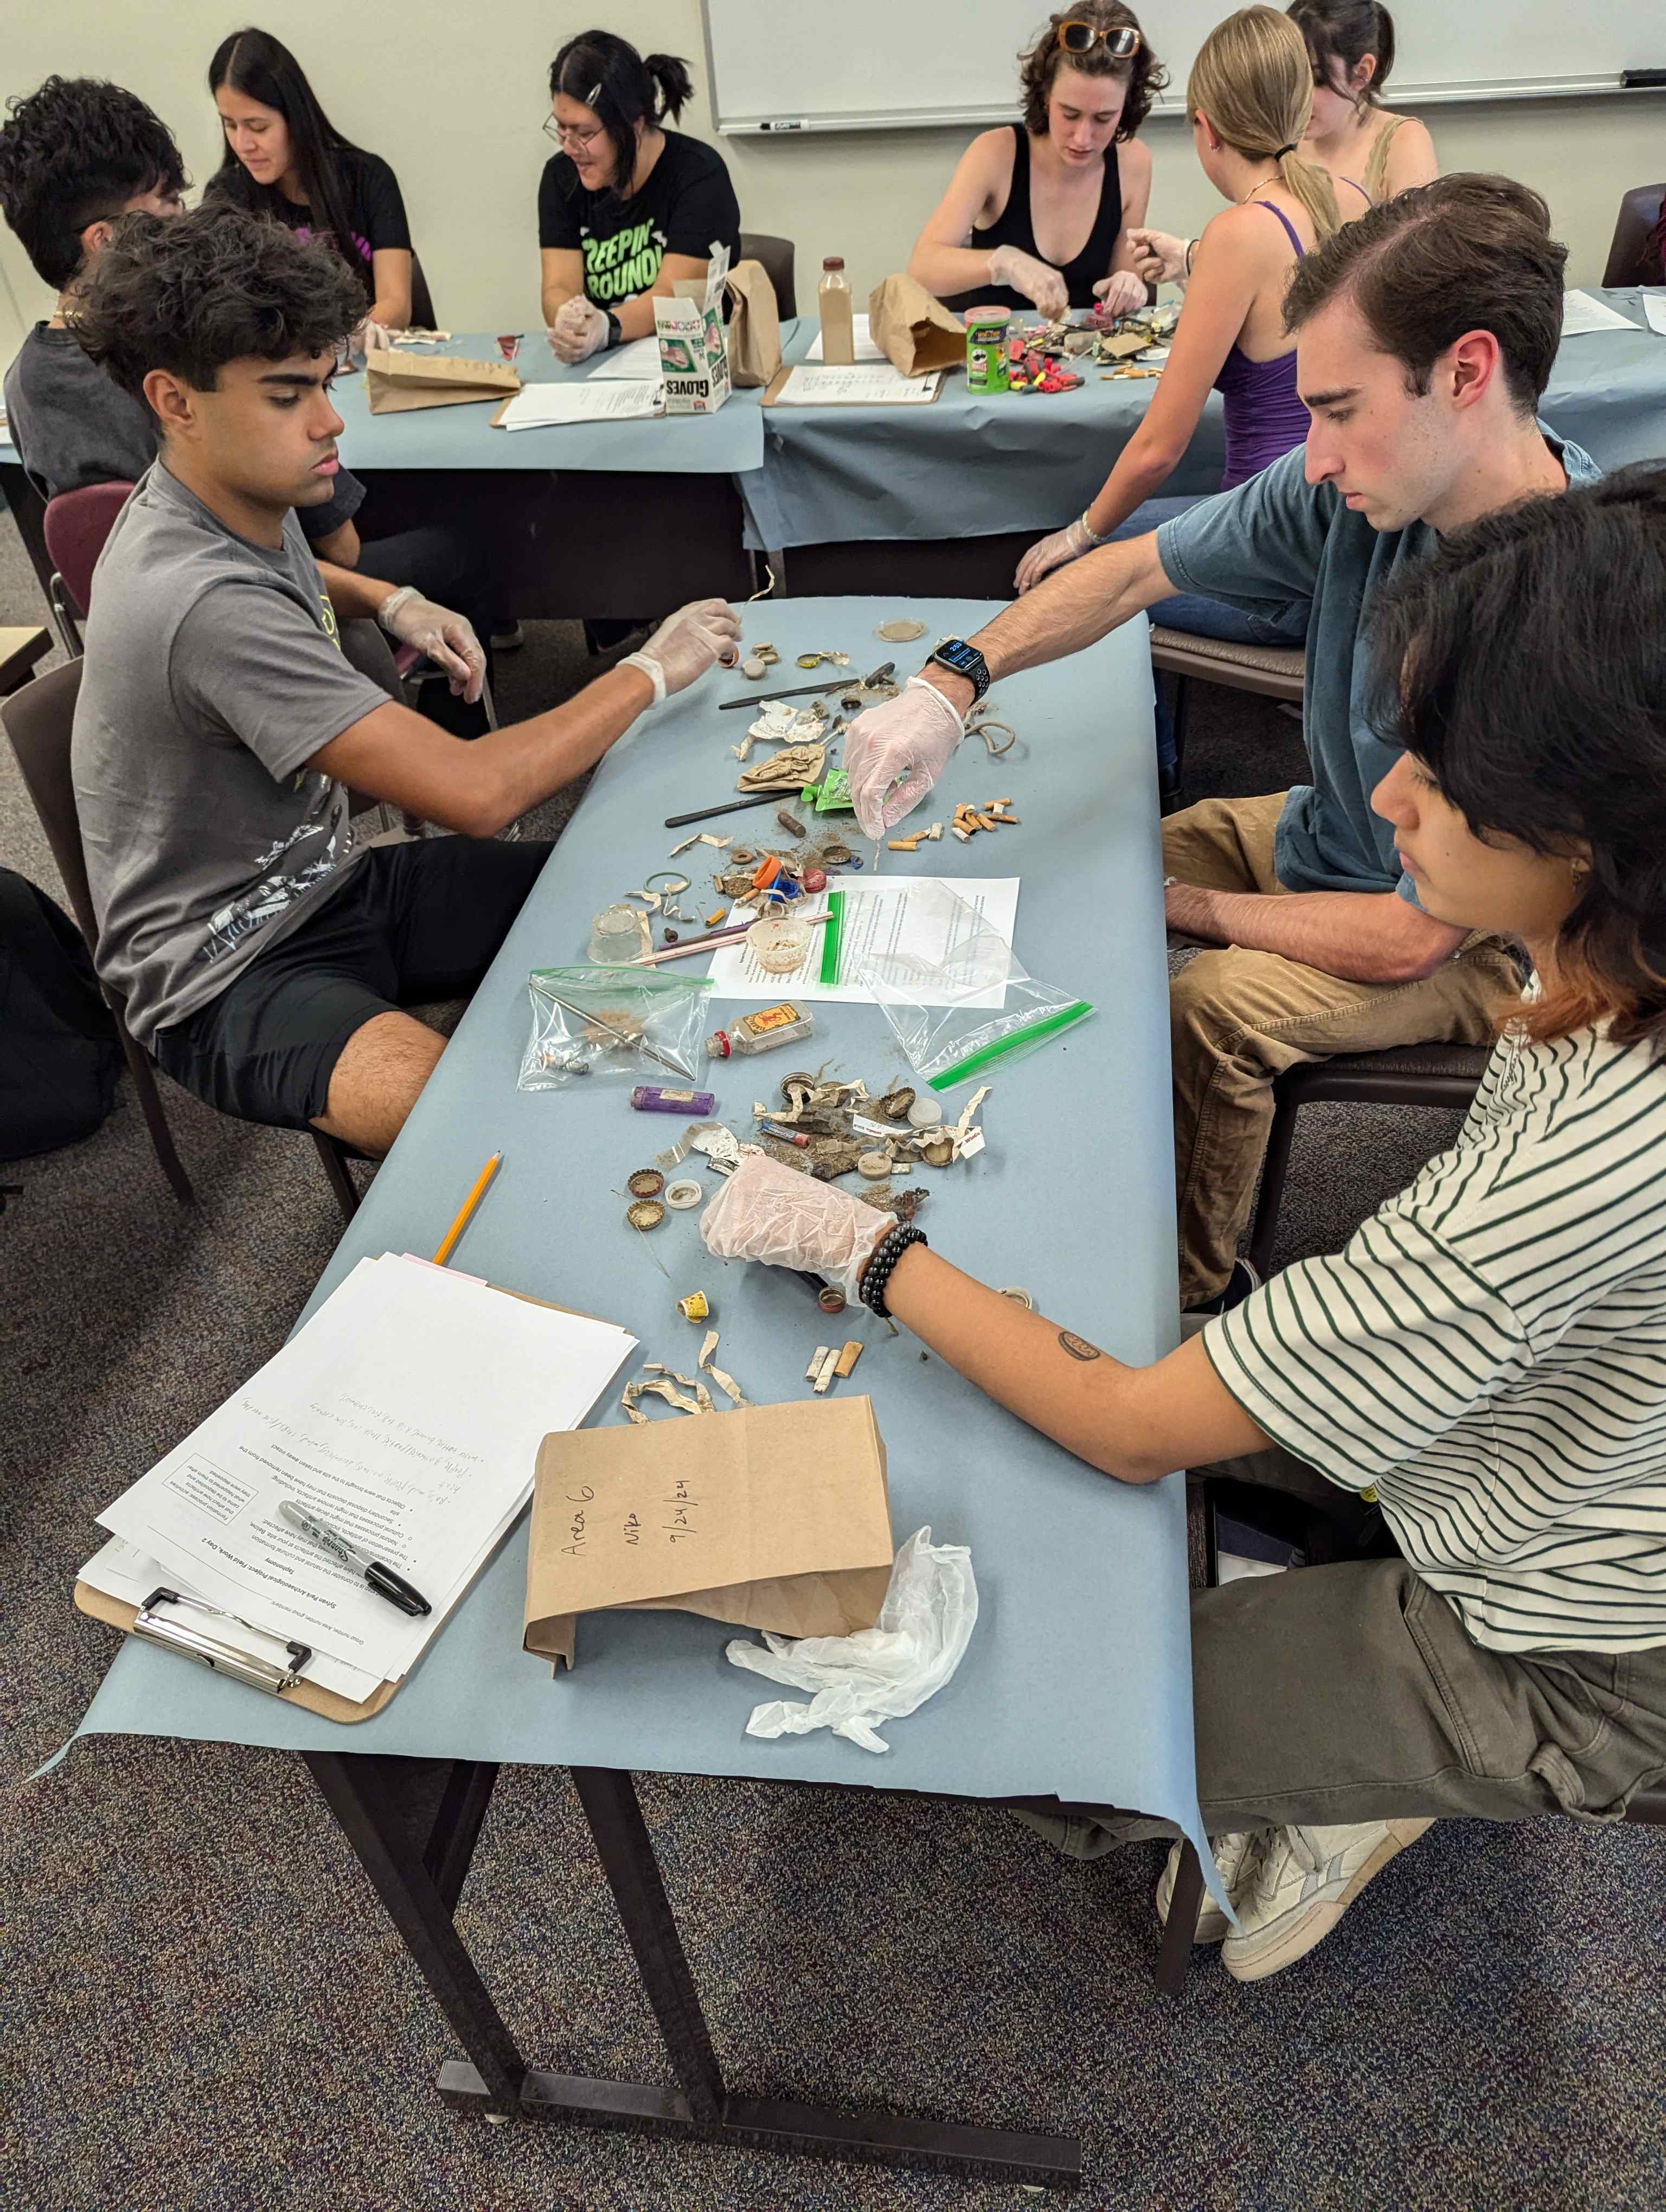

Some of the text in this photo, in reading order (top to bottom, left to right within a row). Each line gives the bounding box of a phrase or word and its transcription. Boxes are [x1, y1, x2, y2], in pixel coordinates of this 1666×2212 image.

[587, 245, 662, 300] ROUND!
[666, 380, 709, 398] GLOVES
[238, 1445, 248, 1454] the
[246, 1450, 260, 1460] from
[270, 1443, 287, 1455] intact
[285, 1451, 300, 1462] away
[185, 1464, 198, 1474] after
[258, 1457, 282, 1472] removed
[297, 1459, 313, 1470] taken
[195, 1471, 209, 1481] them
[279, 1470, 294, 1481] been
[311, 1467, 323, 1475] and
[185, 1473, 196, 1482] and
[207, 1469, 252, 1497] they were deposited.
[269, 1474, 297, 1491] including:
[292, 1478, 307, 1487] have
[194, 1478, 218, 1495] deposited
[212, 1480, 235, 1496] happened
[305, 1483, 318, 1491] may
[344, 1480, 366, 1492] brought
[168, 1480, 229, 1521] Formation process: activities
[184, 1482, 234, 1515] that affect how artifacts
[232, 1494, 245, 1503] what
[294, 1488, 318, 1501] artifacts,
[325, 1491, 349, 1504] deposits
[226, 1499, 240, 1508] came
[294, 1499, 316, 1510] artifacts
[316, 1498, 335, 1508] remove
[345, 1500, 369, 1513] disposal
[385, 1496, 407, 1509] Objects
[314, 1506, 331, 1517] decay
[333, 1504, 350, 1515] might
[366, 1508, 395, 1523] Secondary
[661, 1480, 699, 1544] 9/24/24
[328, 1513, 345, 1523] might
[342, 1519, 355, 1527] that
[358, 1515, 386, 1529] processes
[561, 1486, 594, 1556] Area 6
[247, 1521, 267, 1534] Below,
[260, 1518, 319, 1548] that may have affected:
[354, 1523, 381, 1537] processes
[382, 1526, 405, 1538] Cultural
[624, 1513, 641, 1545] Niko
[275, 1535, 290, 1544] your
[339, 1527, 364, 1541] artifacts,
[378, 1534, 399, 1546] Natural
[204, 1539, 220, 1550] Day
[250, 1534, 277, 1550] formation
[367, 1539, 400, 1557] preservation
[216, 1546, 235, 1560] Work,
[274, 1547, 296, 1559] cultural
[292, 1544, 315, 1557] artifacts
[232, 1557, 248, 1568] Field
[263, 1557, 296, 1574] Taphonomy
[303, 1560, 323, 1571] natural
[321, 1557, 344, 1569] affected
[246, 1564, 270, 1578] Project:
[342, 1566, 356, 1575] have
[329, 1571, 354, 1584] consider
[267, 1574, 308, 1596] Archaeological
[304, 1592, 319, 1600] Park
[317, 1597, 338, 1609] Sylvan
